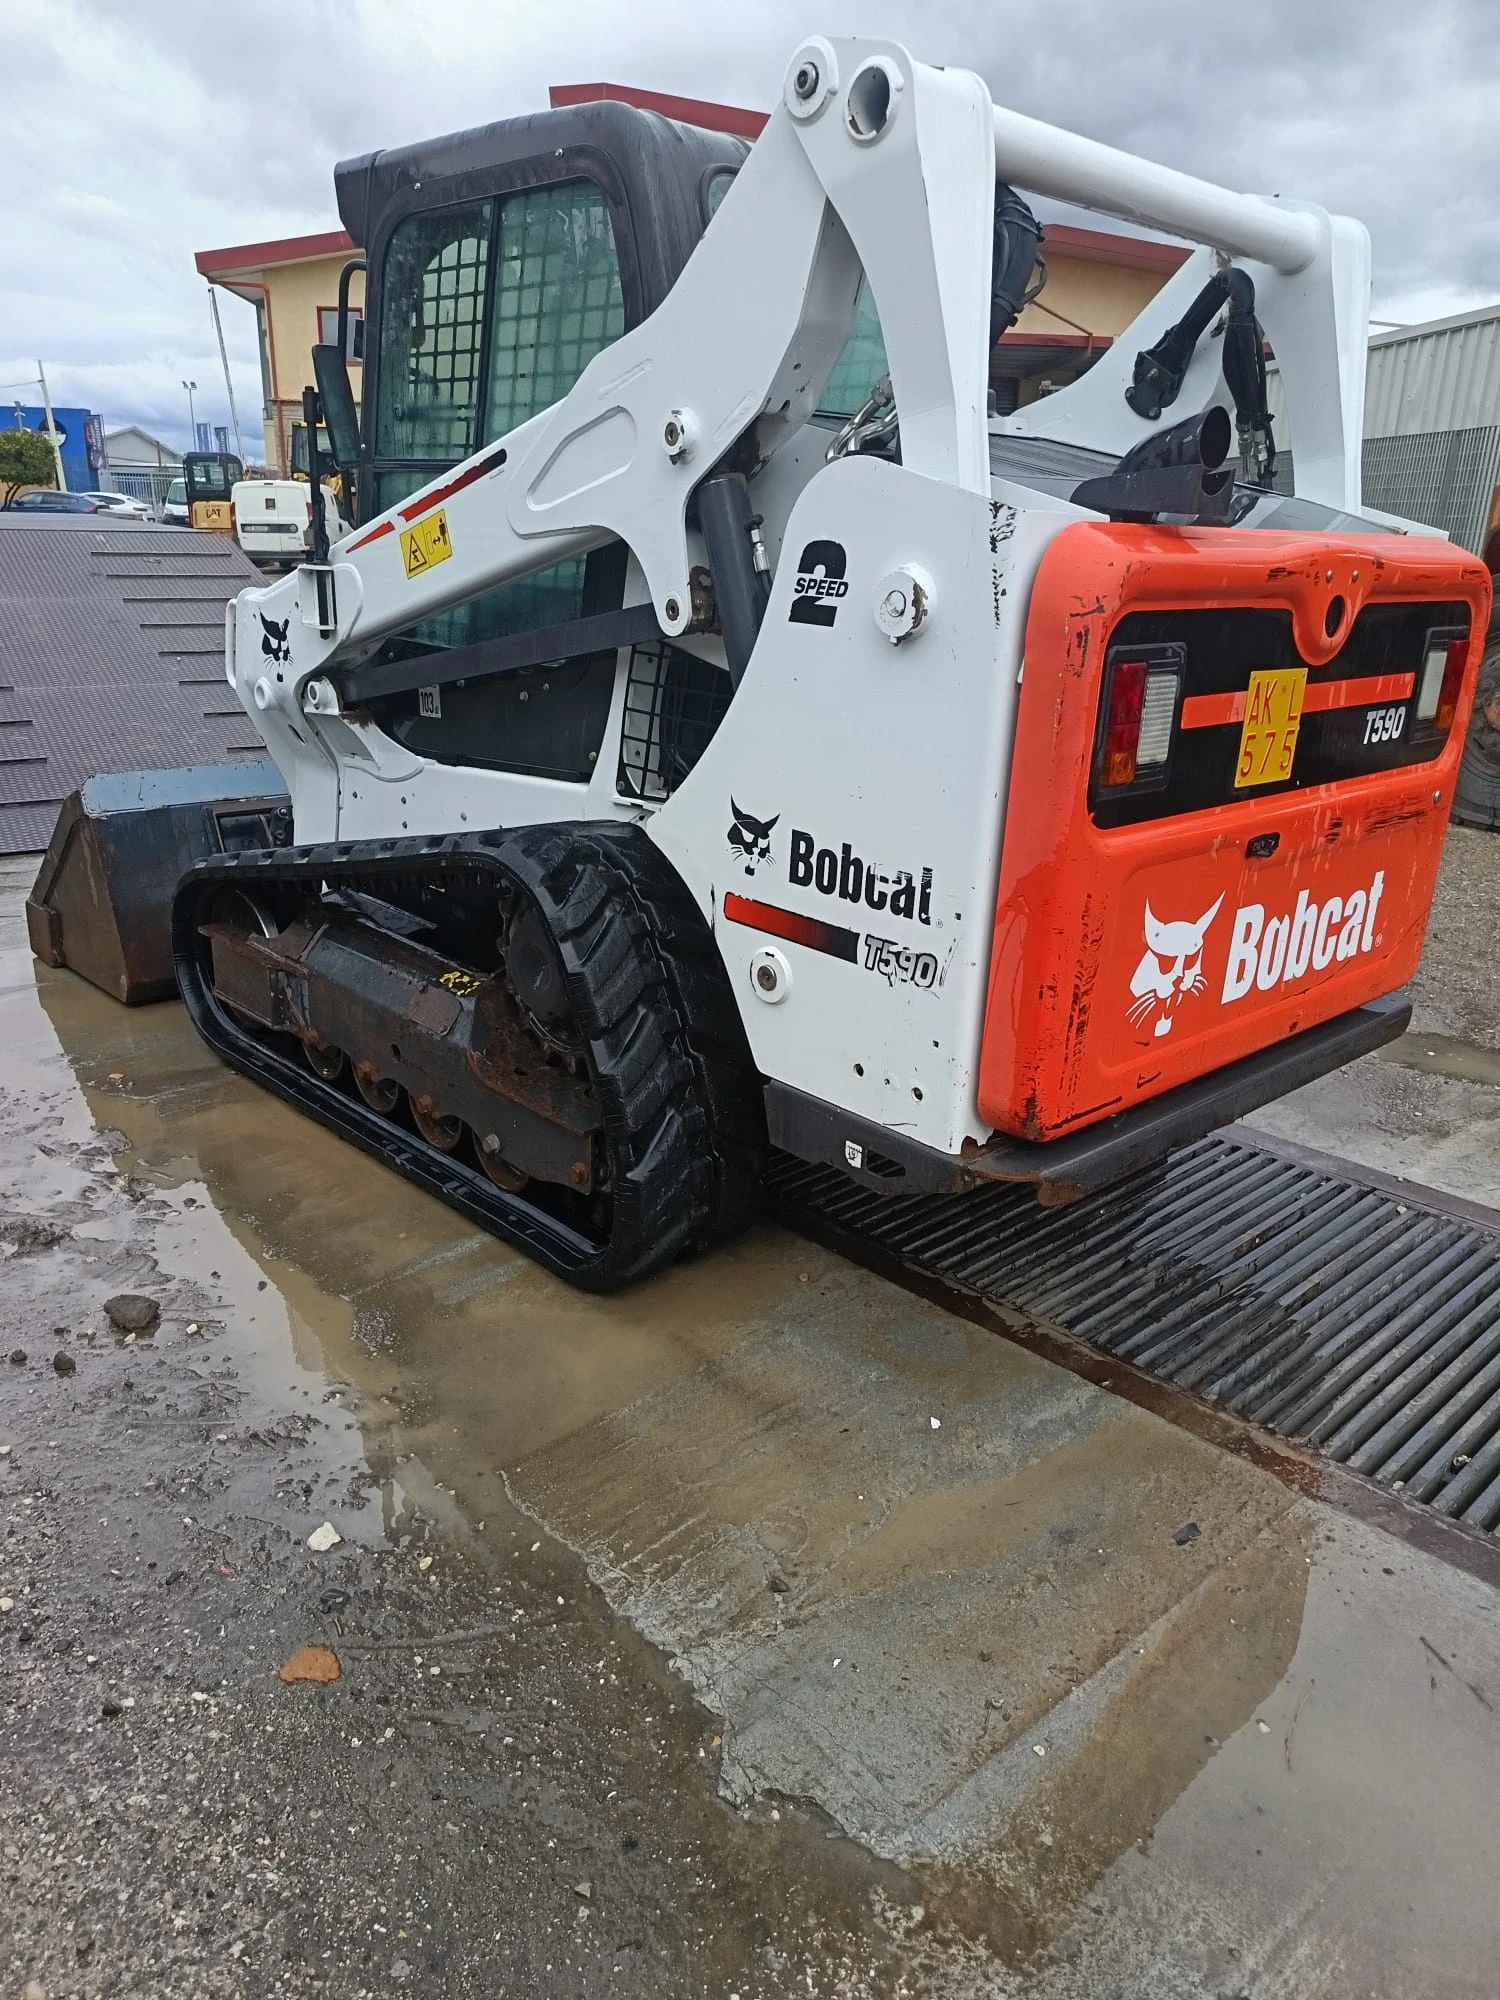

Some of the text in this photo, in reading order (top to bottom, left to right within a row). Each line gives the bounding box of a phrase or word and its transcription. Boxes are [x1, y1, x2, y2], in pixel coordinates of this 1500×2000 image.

[206, 508, 221, 518] CAT
[789, 540, 847, 627] 2
[794, 577, 849, 598] SPEED
[420, 691, 434, 713] 103
[1247, 677, 1299, 726] AK L
[1363, 706, 1406, 745] T590
[789, 829, 934, 926] Bobcat
[864, 934, 938, 989] T590
[1221, 870, 1384, 1005] Bobcat
